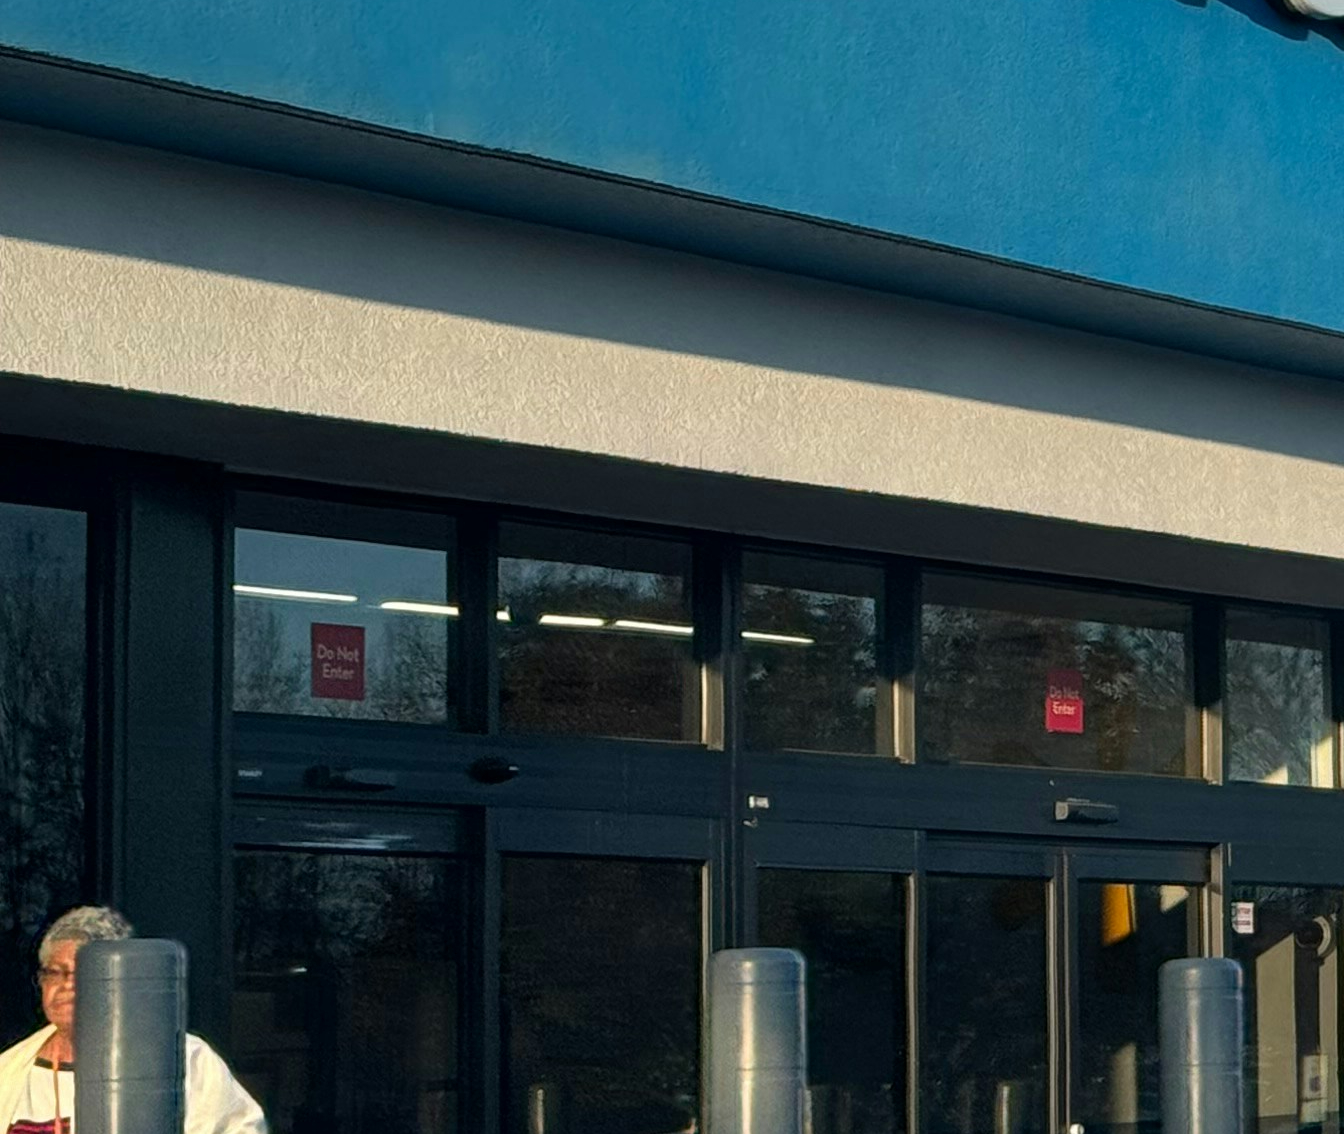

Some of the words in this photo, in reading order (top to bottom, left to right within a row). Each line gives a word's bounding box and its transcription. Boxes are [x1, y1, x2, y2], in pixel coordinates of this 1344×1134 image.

[317, 644, 334, 660] Do
[337, 646, 360, 663] Not
[322, 663, 355, 680] Enter
[1050, 685, 1062, 699] Do
[1063, 686, 1080, 700] Not
[1052, 701, 1075, 715] Enter
